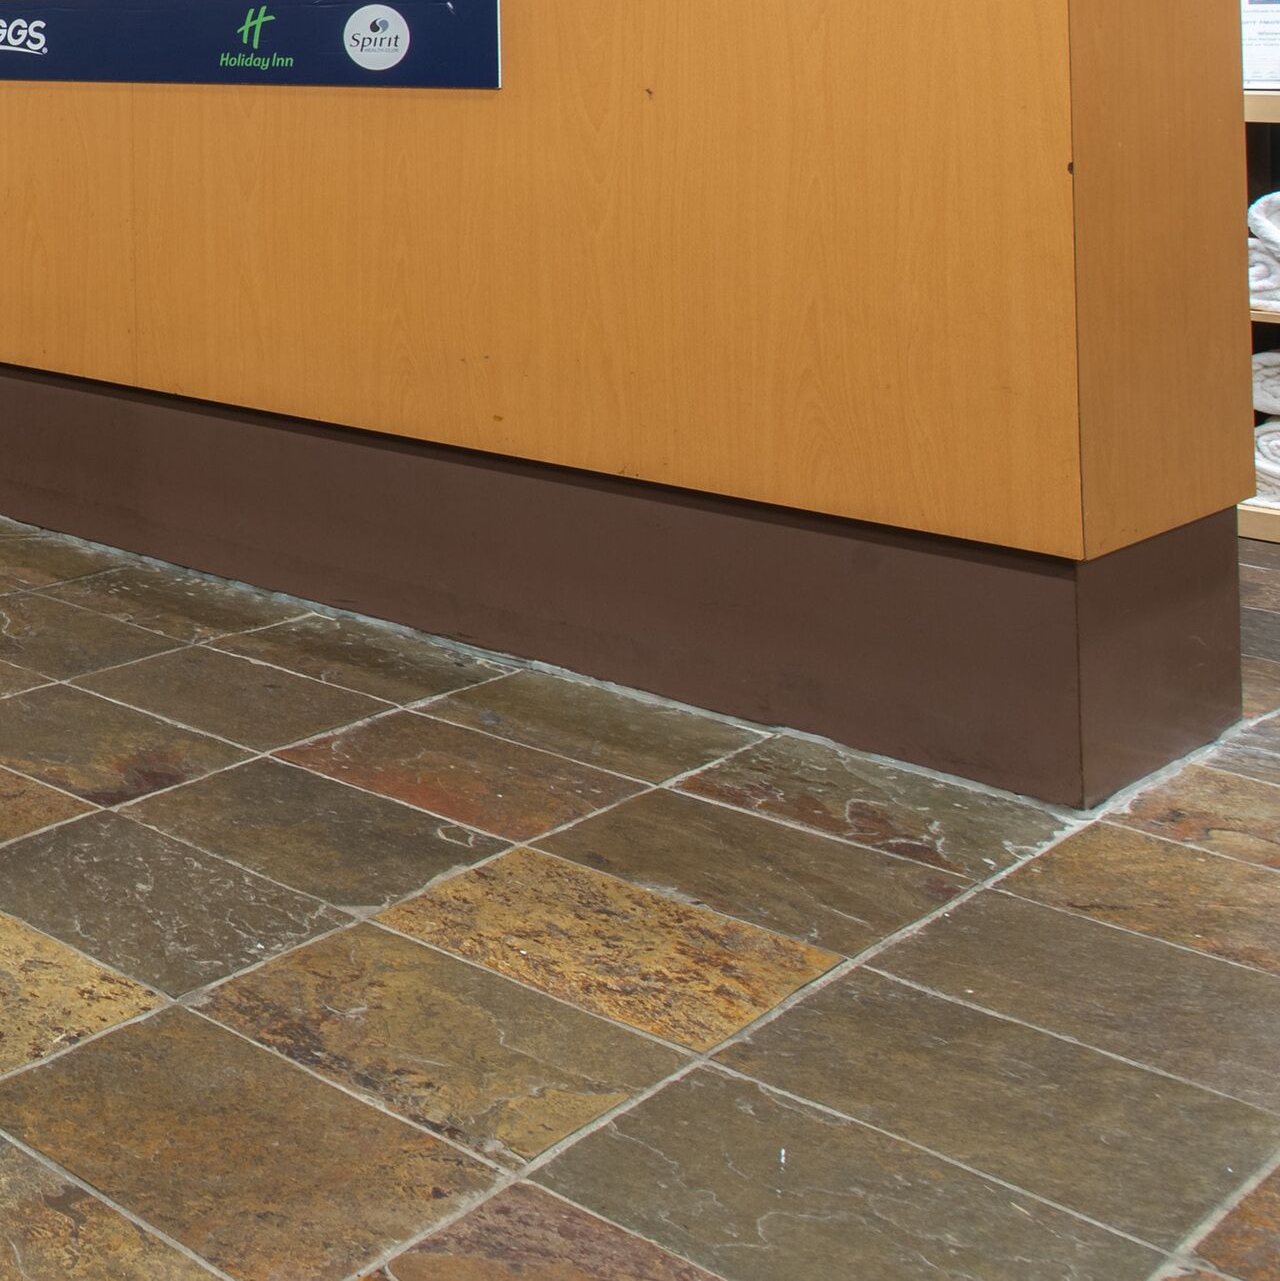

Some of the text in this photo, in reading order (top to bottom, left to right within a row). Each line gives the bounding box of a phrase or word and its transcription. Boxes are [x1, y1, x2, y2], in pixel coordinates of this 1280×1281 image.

[349, 32, 400, 53] Spirit
[220, 51, 294, 70] Holiday Inn
